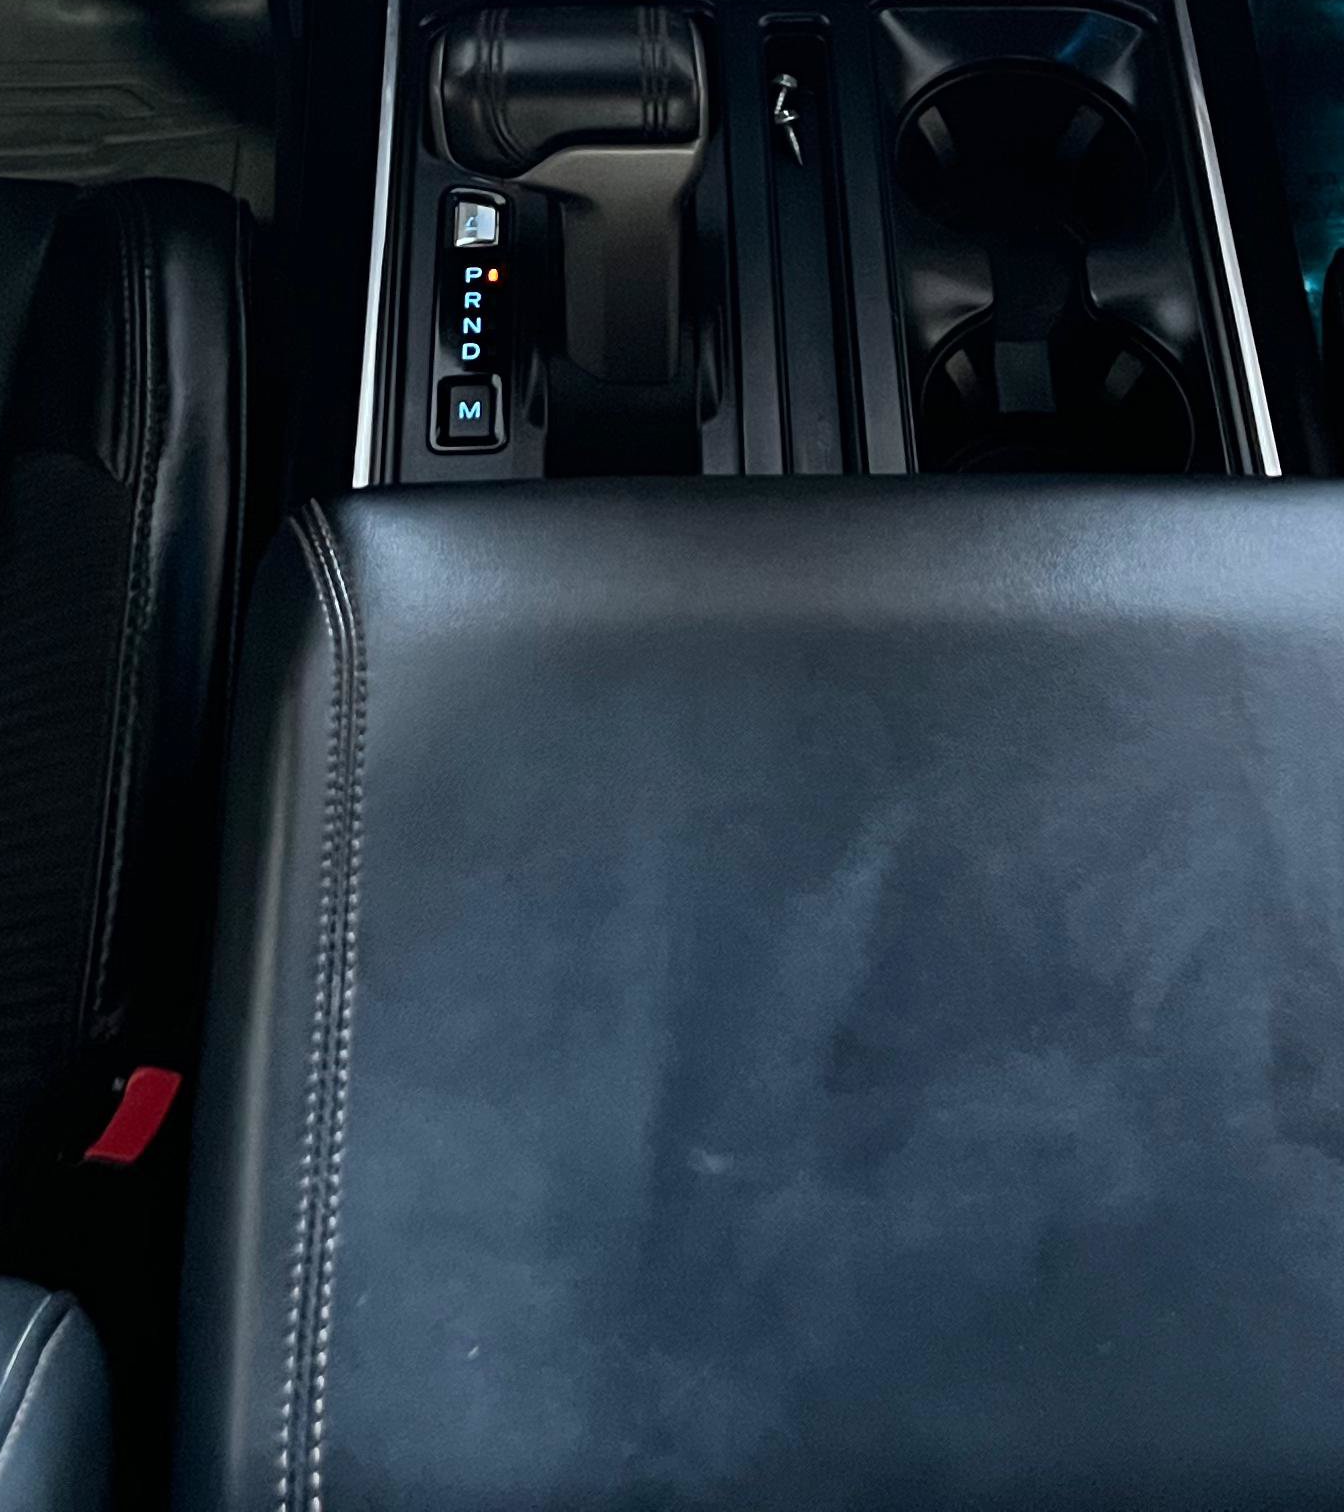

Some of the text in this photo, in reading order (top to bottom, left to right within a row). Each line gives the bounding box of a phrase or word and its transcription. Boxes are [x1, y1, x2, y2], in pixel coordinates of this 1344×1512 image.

[464, 266, 483, 284] P
[464, 291, 482, 309] R
[462, 317, 481, 335] N
[461, 342, 481, 361] D
[458, 401, 481, 420] M
